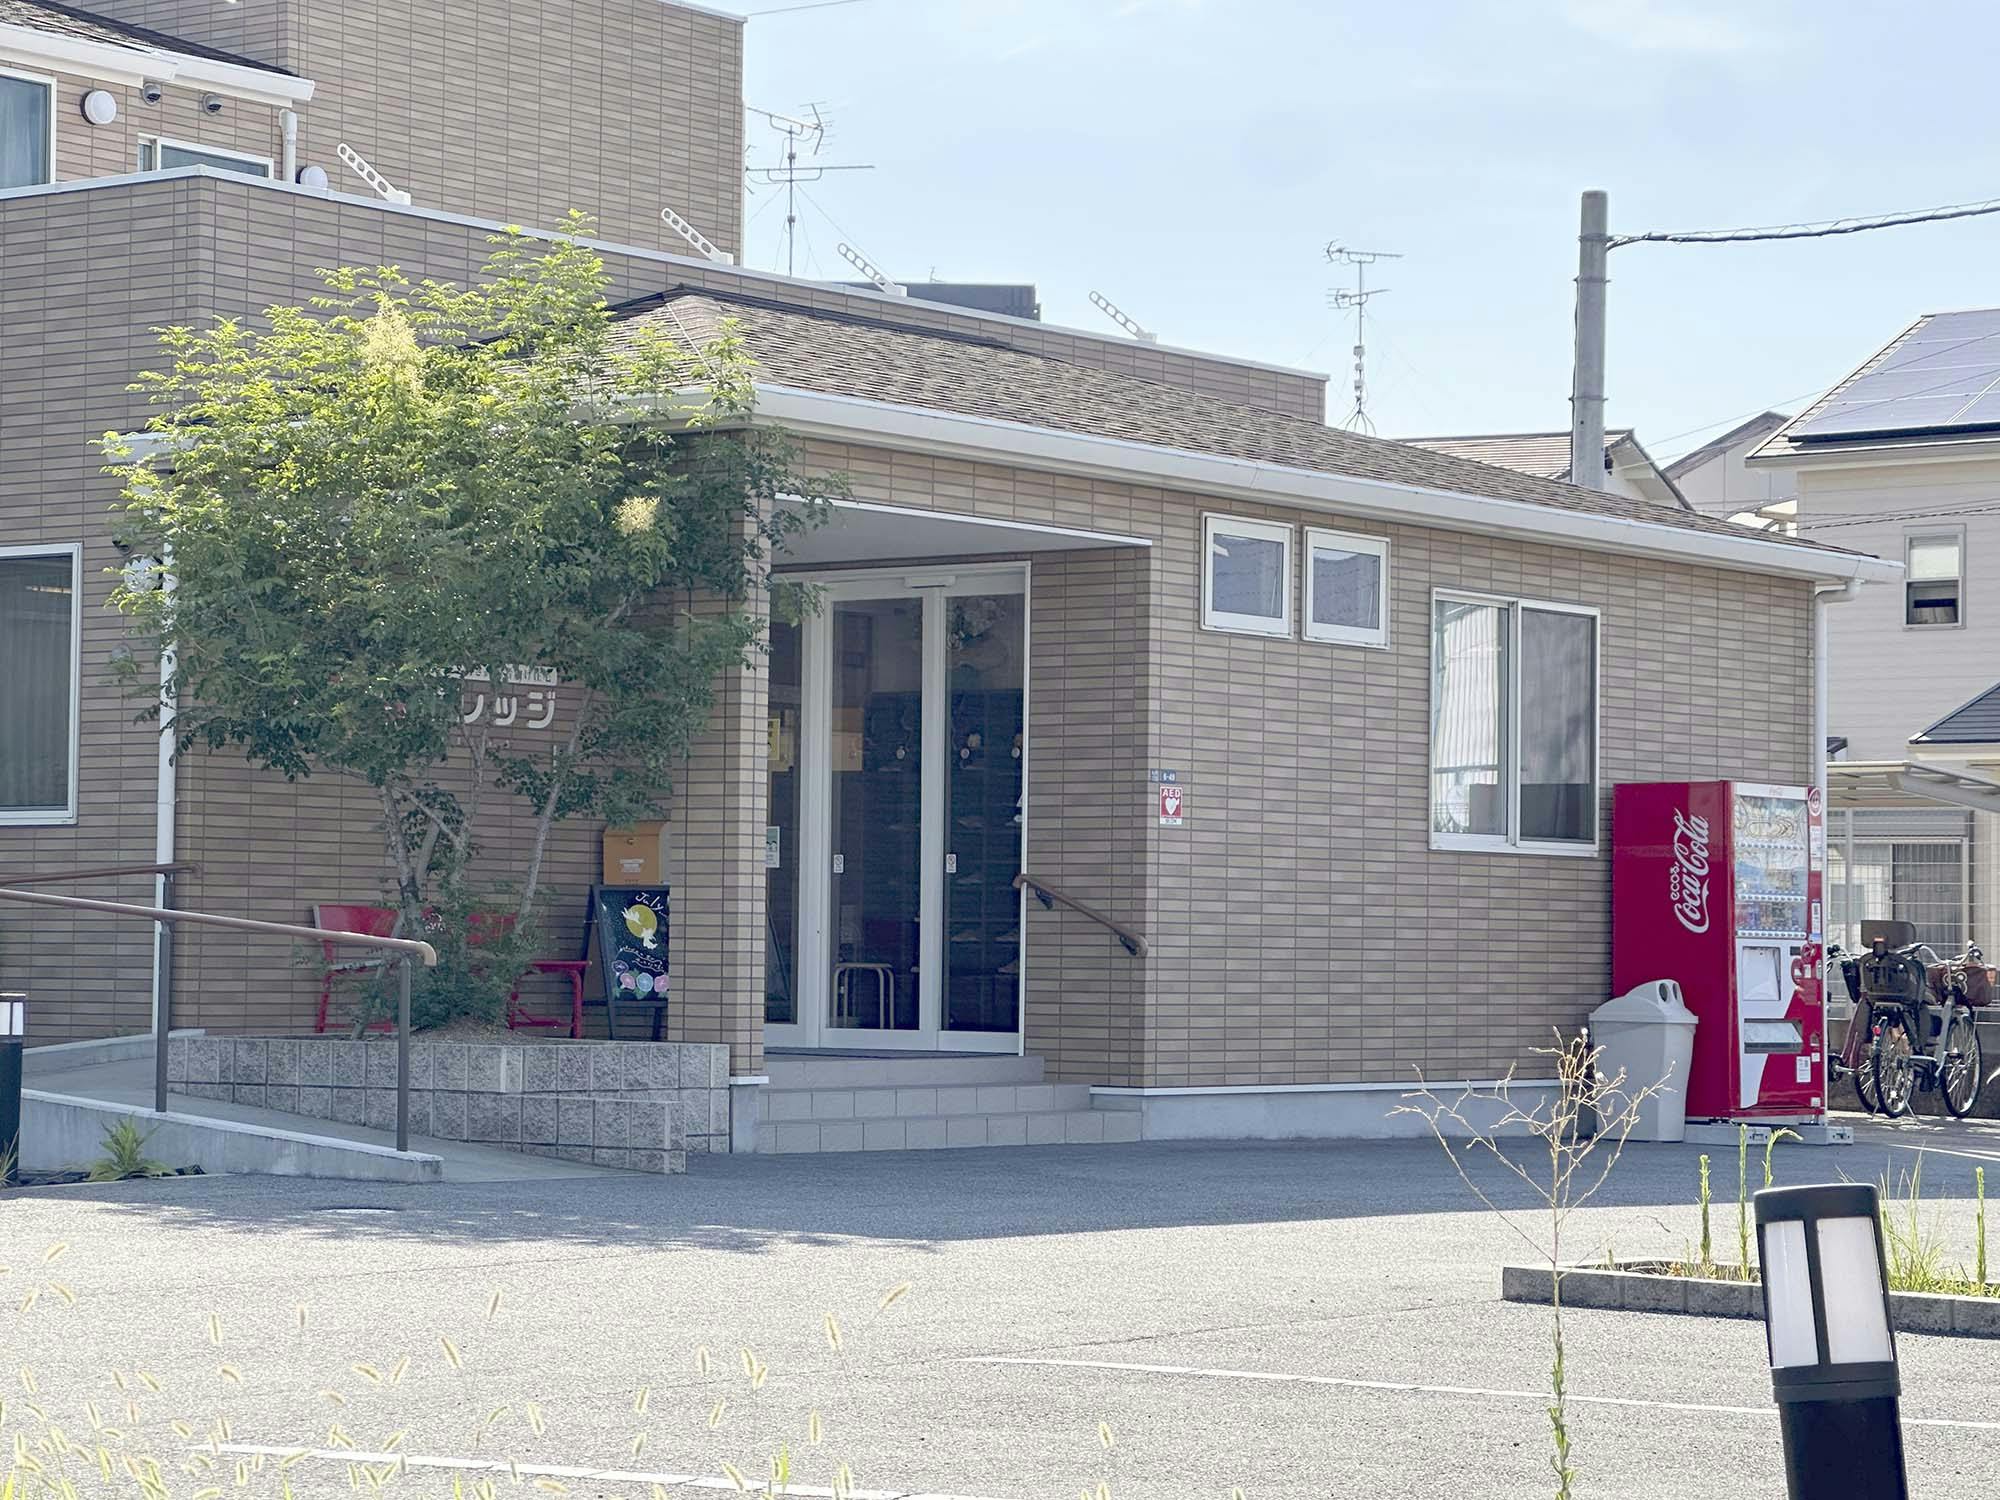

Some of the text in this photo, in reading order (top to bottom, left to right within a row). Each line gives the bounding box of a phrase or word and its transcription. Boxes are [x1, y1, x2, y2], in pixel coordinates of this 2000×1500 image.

[1162, 788, 1181, 797] AED
[1673, 807, 1710, 933] Coca-Cola
[635, 892, 665, 911] July
